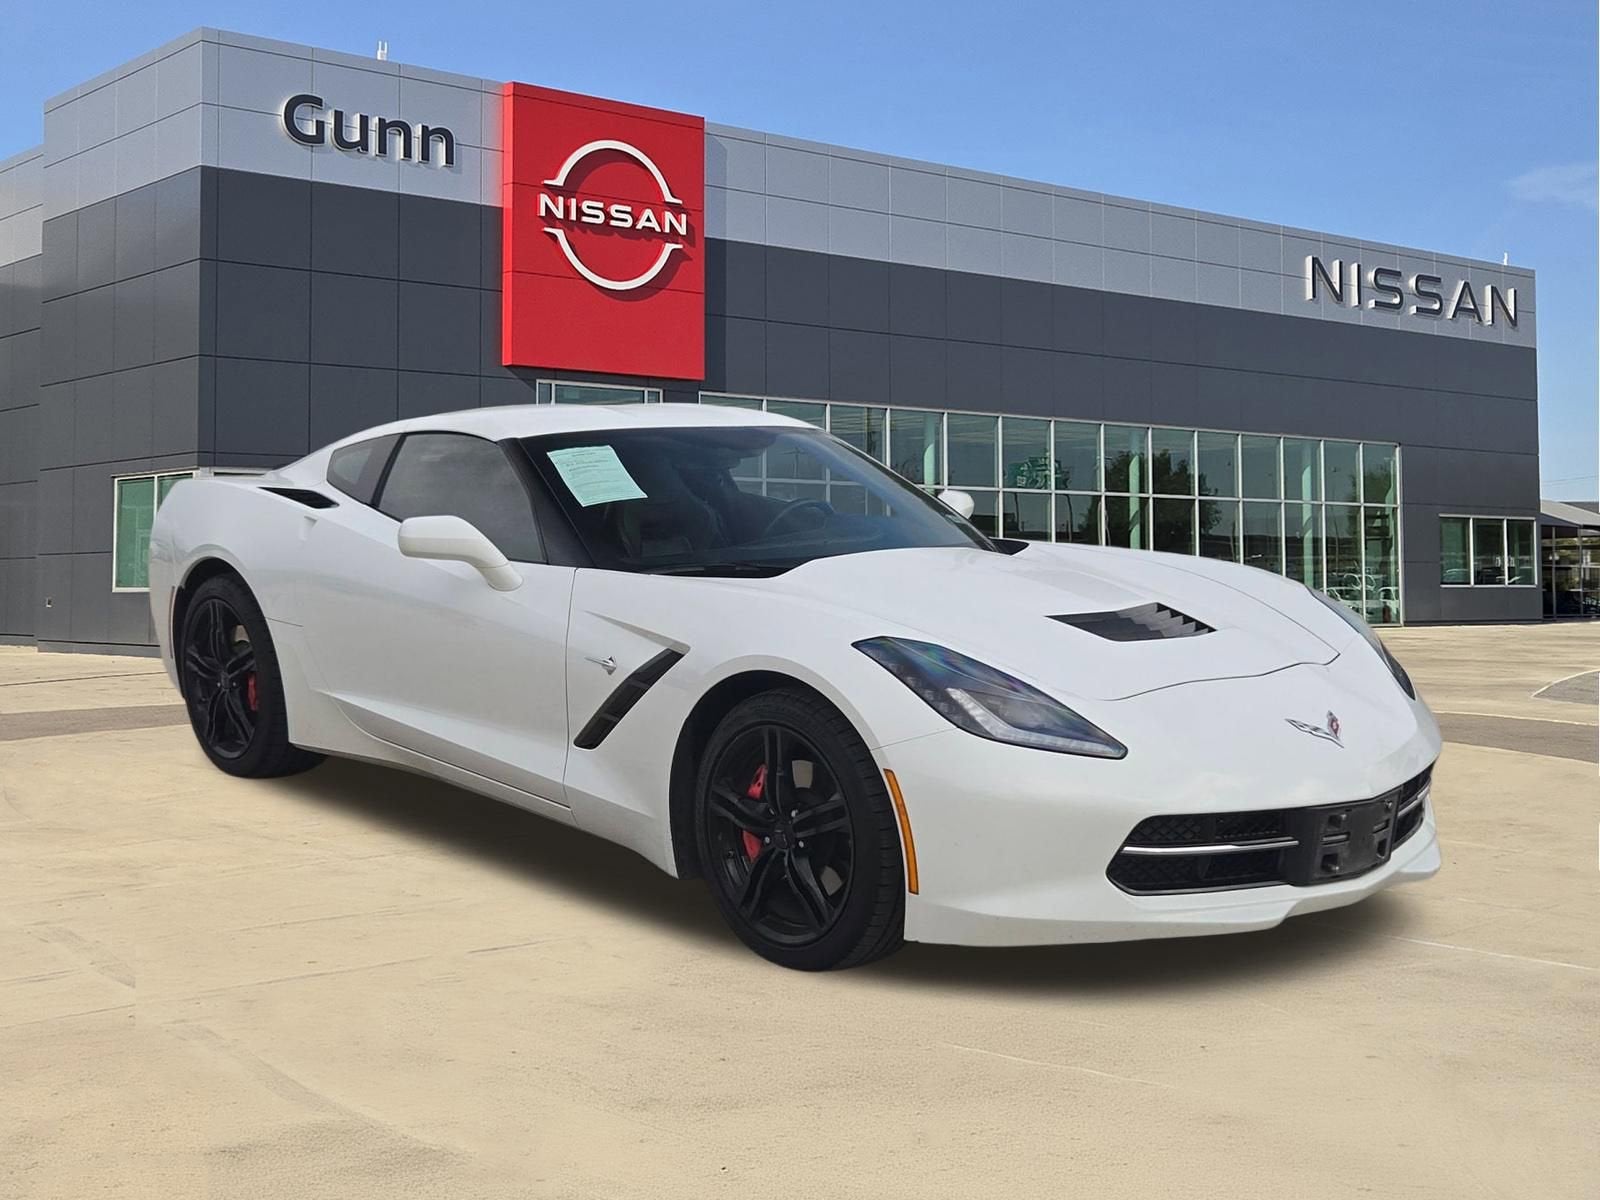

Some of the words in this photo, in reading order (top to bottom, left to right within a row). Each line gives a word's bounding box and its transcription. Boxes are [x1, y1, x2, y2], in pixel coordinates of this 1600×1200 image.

[282, 93, 455, 167] Gunn
[537, 193, 688, 236] NISSAN
[1305, 255, 1518, 328] NISSAN
